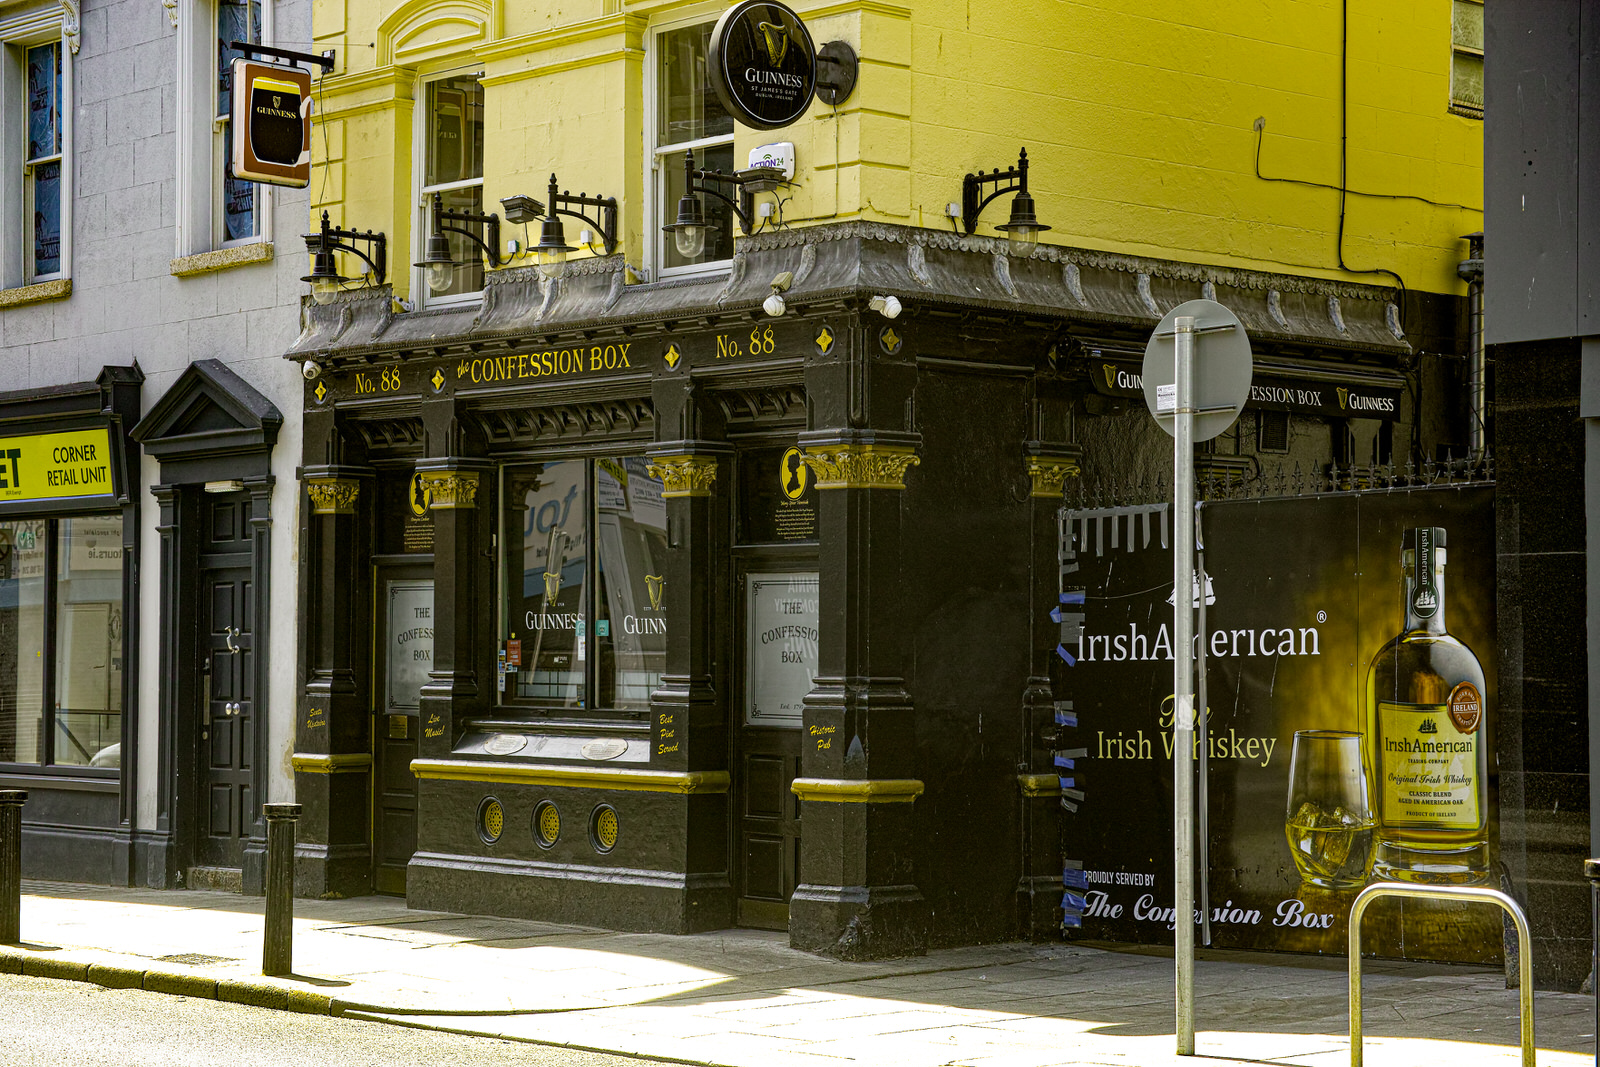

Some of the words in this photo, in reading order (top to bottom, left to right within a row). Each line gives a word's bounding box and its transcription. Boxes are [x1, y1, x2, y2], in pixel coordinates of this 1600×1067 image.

[745, 67, 803, 88] GUINNESS
[256, 105, 297, 120] GUINNESS
[716, 334, 743, 359] No.
[749, 324, 776, 355] 88
[457, 358, 470, 379] the
[470, 347, 585, 384] CONFESSION
[589, 343, 632, 371] BOX
[354, 372, 376, 394] No.
[381, 366, 401, 392] 88
[1297, 389, 1322, 407] BOX
[1349, 393, 1395, 412] GUINNESS
[53, 444, 97, 464] CORNER
[47, 467, 79, 487] RETAIL
[80, 466, 107, 485] UNIT
[1421, 528, 1429, 585] IrishAmerican
[414, 607, 430, 618] THE
[782, 602, 803, 615] THE
[1077, 622, 1320, 662] IrishAerican
[413, 650, 431, 661] BOX
[781, 651, 803, 664] BOX
[1453, 704, 1478, 712] IRELAND
[427, 713, 441, 724] Live
[659, 713, 674, 725] Best
[660, 728, 675, 741] Pint
[809, 724, 837, 737] Historic
[658, 742, 679, 755] Served
[816, 738, 832, 751] Pub
[1097, 730, 1153, 760] Irish
[1385, 737, 1473, 753] IrishAmerican
[1388, 772, 1417, 785] Original
[1418, 774, 1441, 784] Irish
[1443, 774, 1472, 786] Whiskey
[1083, 870, 1114, 885] PROUDLY
[1115, 872, 1144, 886] SERVED
[1144, 873, 1155, 887] BY
[1082, 890, 1123, 919] The
[1272, 898, 1335, 929] Box
